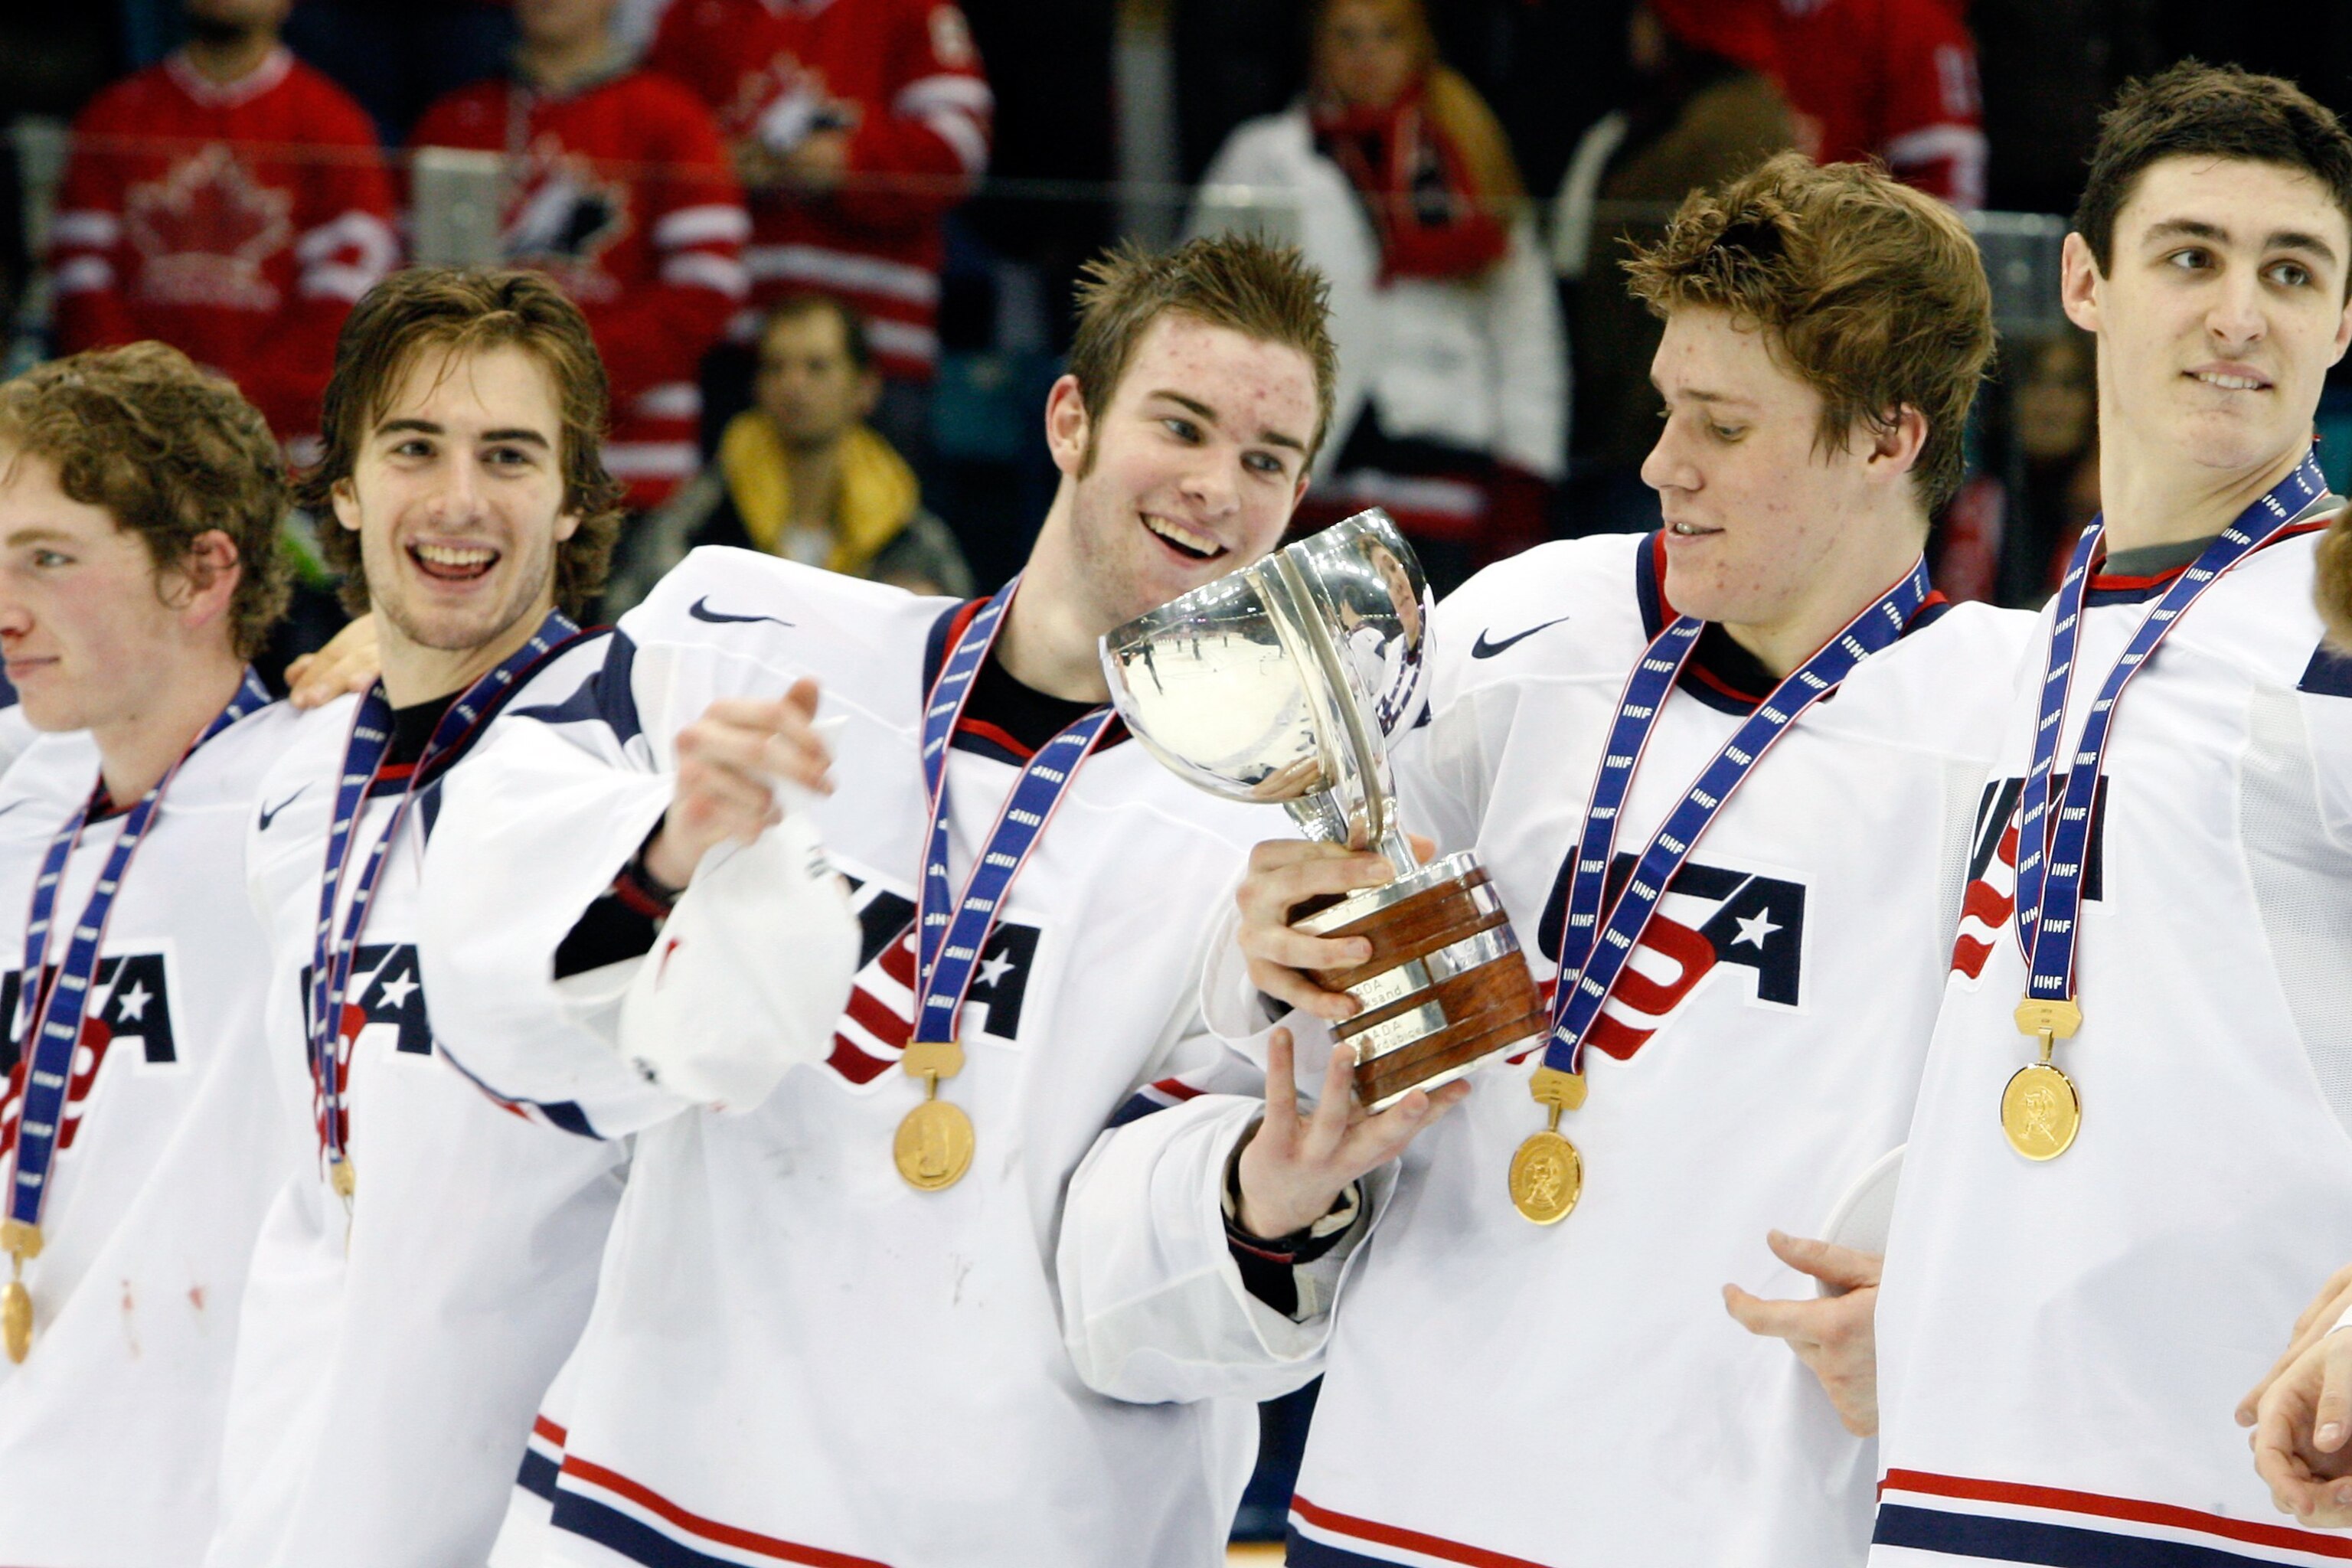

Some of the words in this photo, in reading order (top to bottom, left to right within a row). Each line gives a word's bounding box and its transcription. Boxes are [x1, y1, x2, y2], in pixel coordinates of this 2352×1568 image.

[2222, 528, 2252, 545] IIHF
[2186, 568, 2213, 582] IIHF
[2151, 609, 2177, 621] IIHF
[2055, 614, 2076, 636] IIHF
[1643, 658, 1674, 673] IIHF
[2120, 654, 2143, 665] IIHF
[1799, 671, 1828, 688] IIHF
[2047, 662, 2069, 683] IIHF
[1622, 704, 1652, 719] IIHF
[2093, 699, 2112, 712] IIHF
[1761, 706, 1788, 724] IIHF
[2040, 709, 2061, 731] IIHF
[1606, 755, 1632, 769] IIHF
[1725, 746, 1753, 766] IIHF
[2076, 752, 2096, 765] IIHF
[1031, 766, 1065, 784] IIHF
[2031, 756, 2052, 778] IIHF
[1690, 789, 1717, 809] IIHF
[1008, 808, 1041, 827] IIHF
[1591, 807, 1615, 819] IIHF
[2024, 802, 2044, 825] IIHF
[2063, 807, 2086, 821] IIHF
[1658, 833, 1686, 854] IIHF
[985, 852, 1017, 868] IIHF
[1580, 860, 1604, 873] IIHF
[2020, 851, 2041, 874] IIHF
[2051, 863, 2078, 877] IIHF
[1632, 880, 1657, 901] IIHF
[963, 897, 994, 912] IIHF
[1570, 913, 1595, 926] IIHF
[2021, 906, 2039, 925] IIH
[2043, 919, 2071, 933] IIHF
[1606, 928, 1631, 949] IIHF
[1563, 969, 1581, 981] IIH
[2034, 975, 2063, 990] IIHF
[1581, 977, 1605, 998] IIHF
[1557, 1026, 1578, 1045] IIHF
